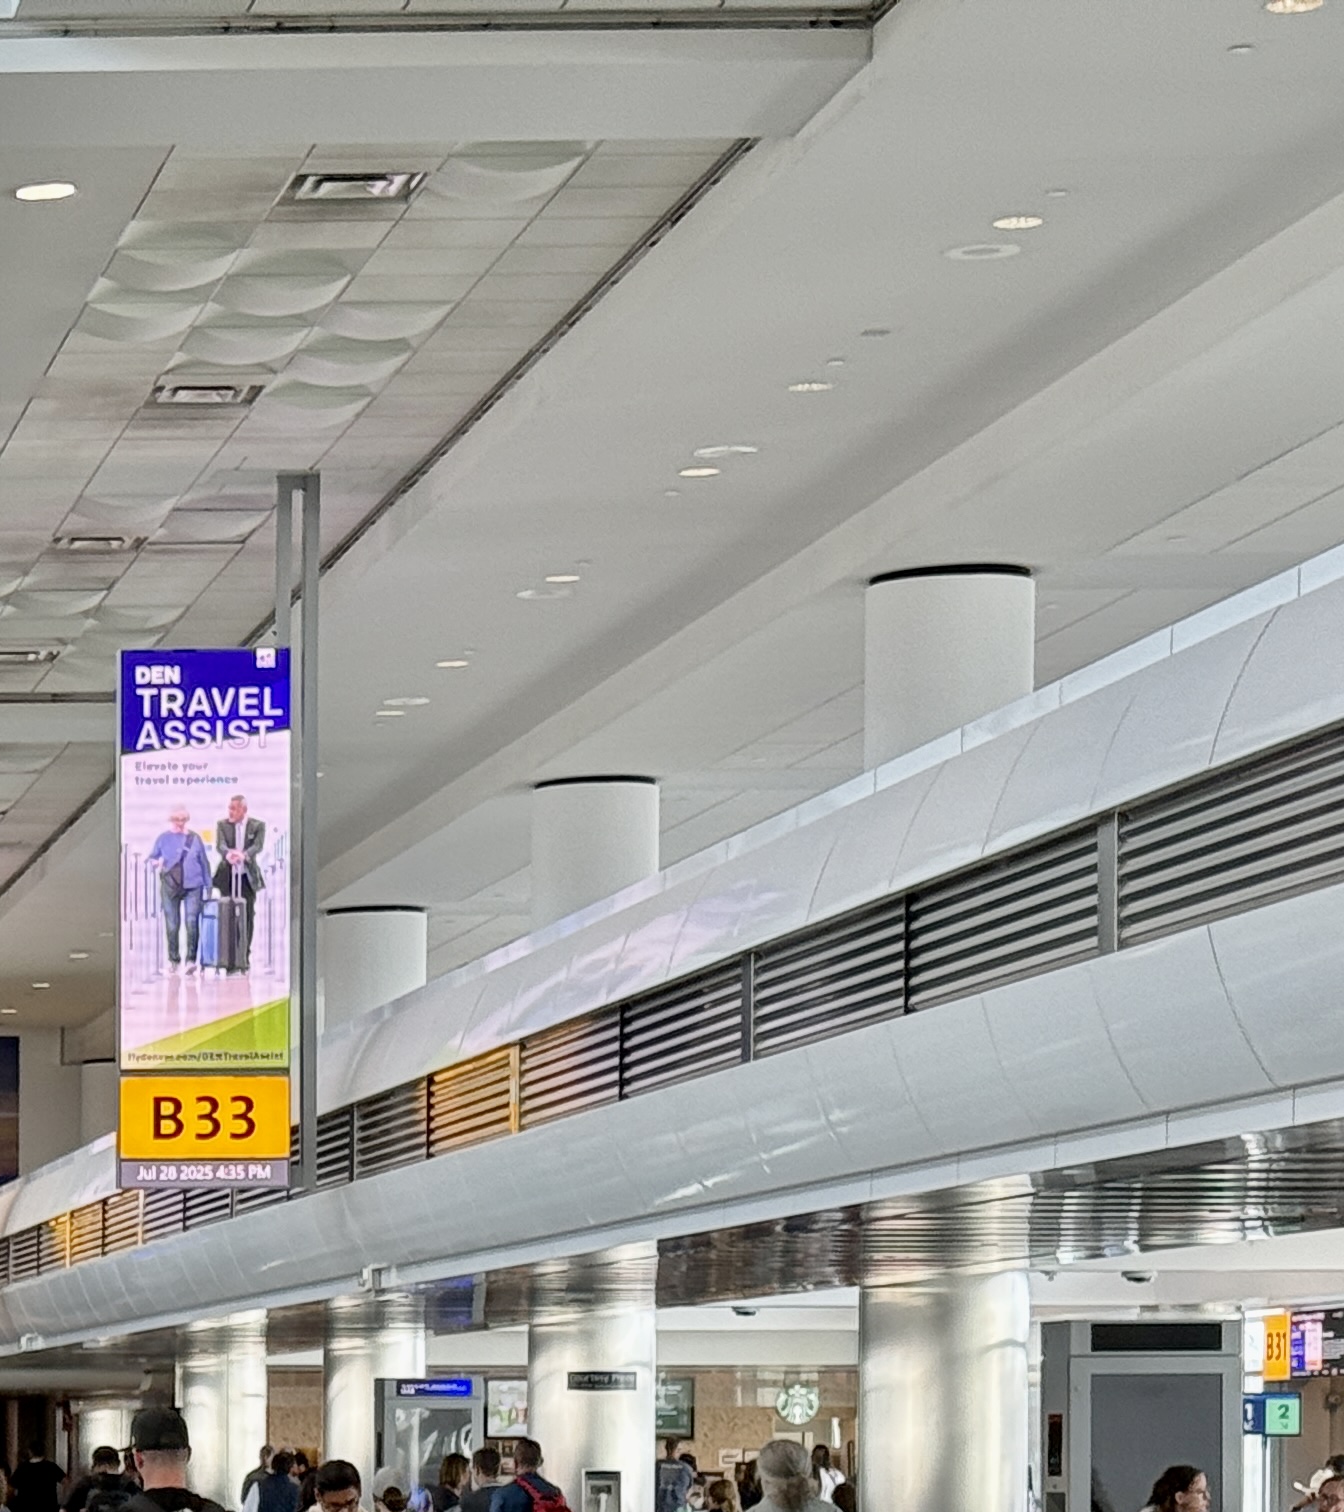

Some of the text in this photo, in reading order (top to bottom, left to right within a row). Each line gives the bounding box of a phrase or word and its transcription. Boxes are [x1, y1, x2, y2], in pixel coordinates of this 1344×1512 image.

[135, 665, 180, 685] DEN
[136, 686, 284, 718] TRAVEL
[136, 719, 275, 750] ASSIST
[153, 1096, 256, 1141] B33
[137, 1164, 271, 1181] Jul 28 2025 4:35 PM
[1266, 1331, 1287, 1361] B31
[1244, 1402, 1254, 1421] 1
[1277, 1403, 1290, 1420] 2
